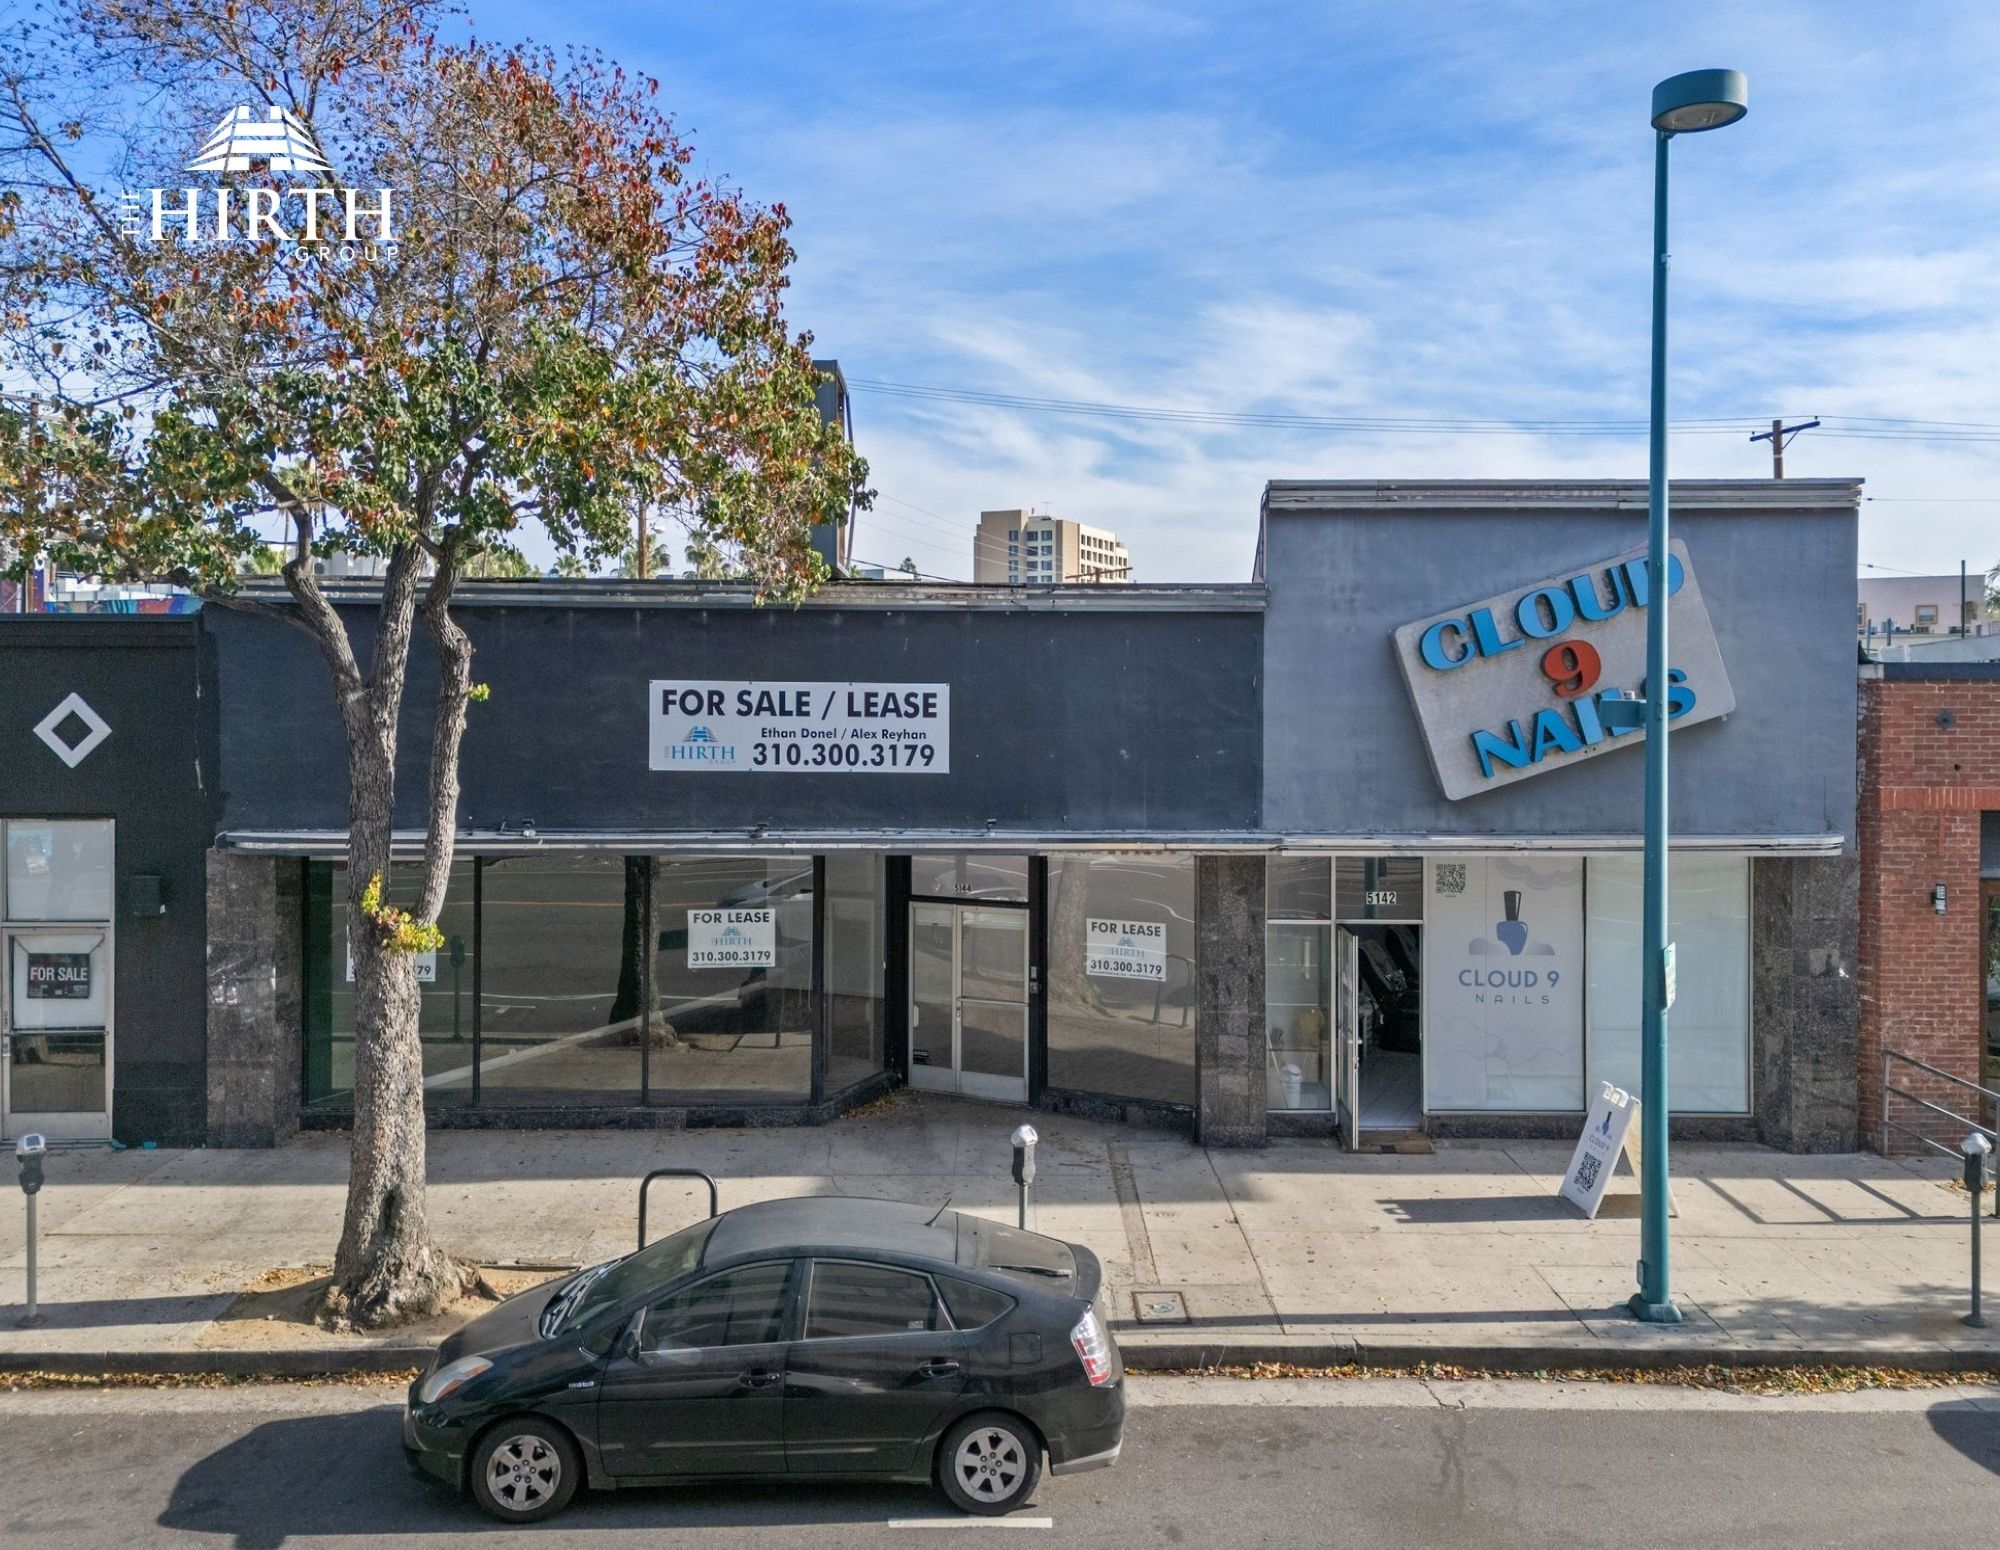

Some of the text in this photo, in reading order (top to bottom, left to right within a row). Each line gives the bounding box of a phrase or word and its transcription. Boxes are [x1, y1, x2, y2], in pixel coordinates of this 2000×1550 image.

[1540, 639, 1602, 698] 9
[661, 689, 938, 720] FOR SALE / LEASE
[761, 727, 927, 742] Ethan Donel / Alex Reyhan
[672, 746, 735, 760] HIRTH
[752, 742, 935, 767] 310.300.3179
[1367, 892, 1395, 904] 5142
[693, 912, 770, 923] FOR LEASE
[1091, 922, 1162, 937] FOR LEASE
[692, 951, 771, 962] 310.300.3179
[31, 967, 88, 981] FOR SALE
[1090, 960, 1162, 974] 310.300.3179
[1458, 969, 1559, 988] CLOUD 9
[1475, 994, 1550, 1004] NAILS
